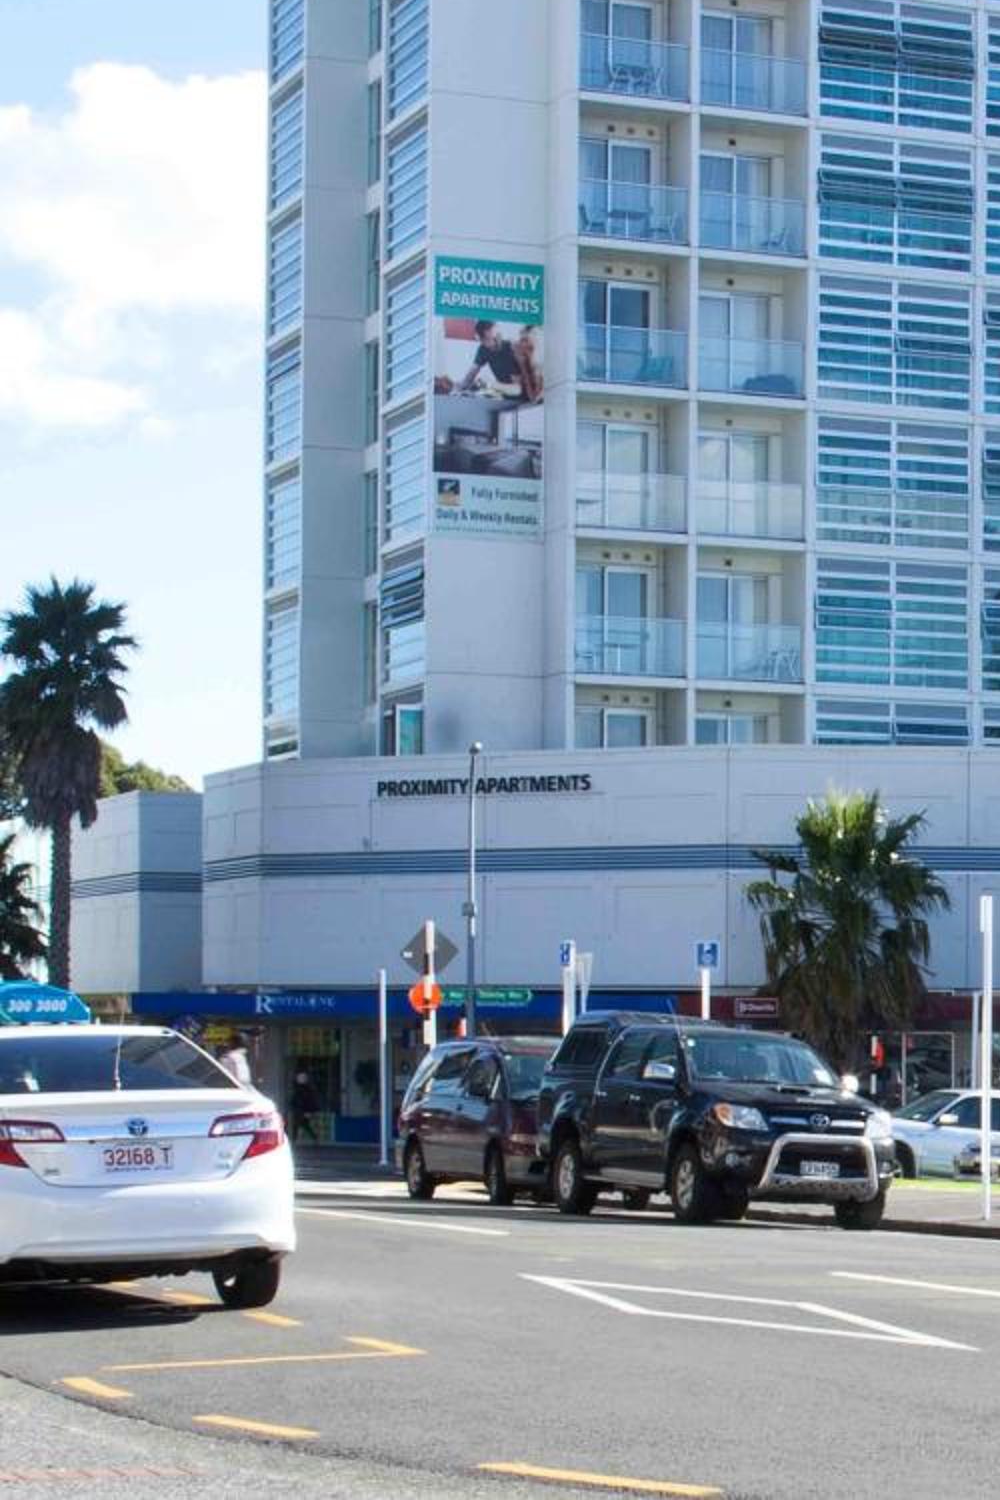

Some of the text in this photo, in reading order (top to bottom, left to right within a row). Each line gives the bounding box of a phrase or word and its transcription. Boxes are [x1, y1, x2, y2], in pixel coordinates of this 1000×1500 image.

[440, 265, 540, 292] PROXIMITY
[441, 292, 540, 314] APARTMENTS
[376, 773, 592, 798] PROXIMITY APARTMENTS
[103, 1148, 155, 1167] 32168
